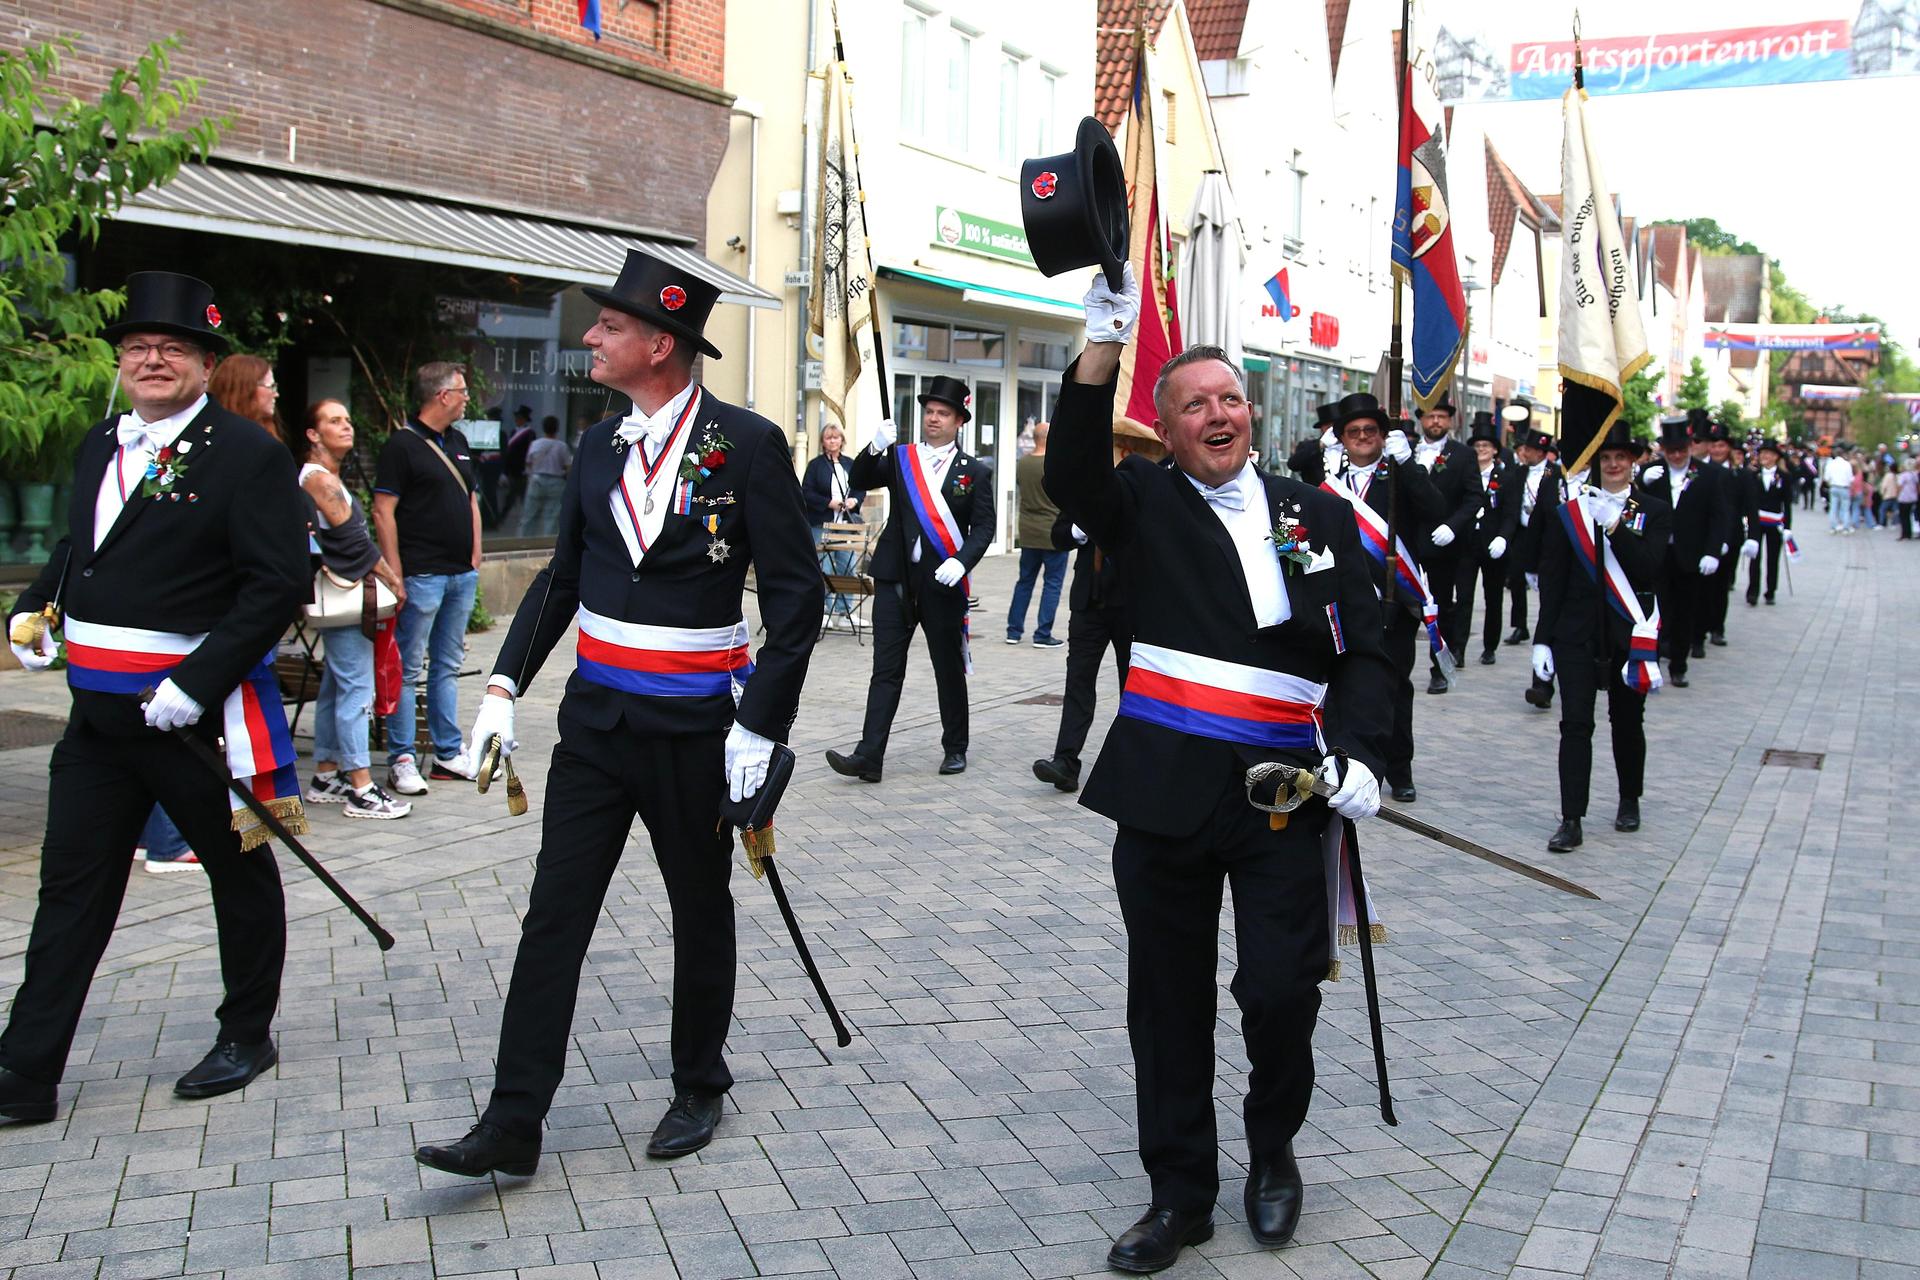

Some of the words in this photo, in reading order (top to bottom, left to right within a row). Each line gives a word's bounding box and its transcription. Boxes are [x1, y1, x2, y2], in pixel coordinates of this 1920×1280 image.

[1517, 28, 1838, 91] Amtspfortenrott
[964, 222, 981, 244] 100
[1572, 252, 1581, 275] die
[1575, 278, 1595, 309] Für
[1261, 303, 1301, 317] ND
[494, 346, 591, 379] FLEURI
